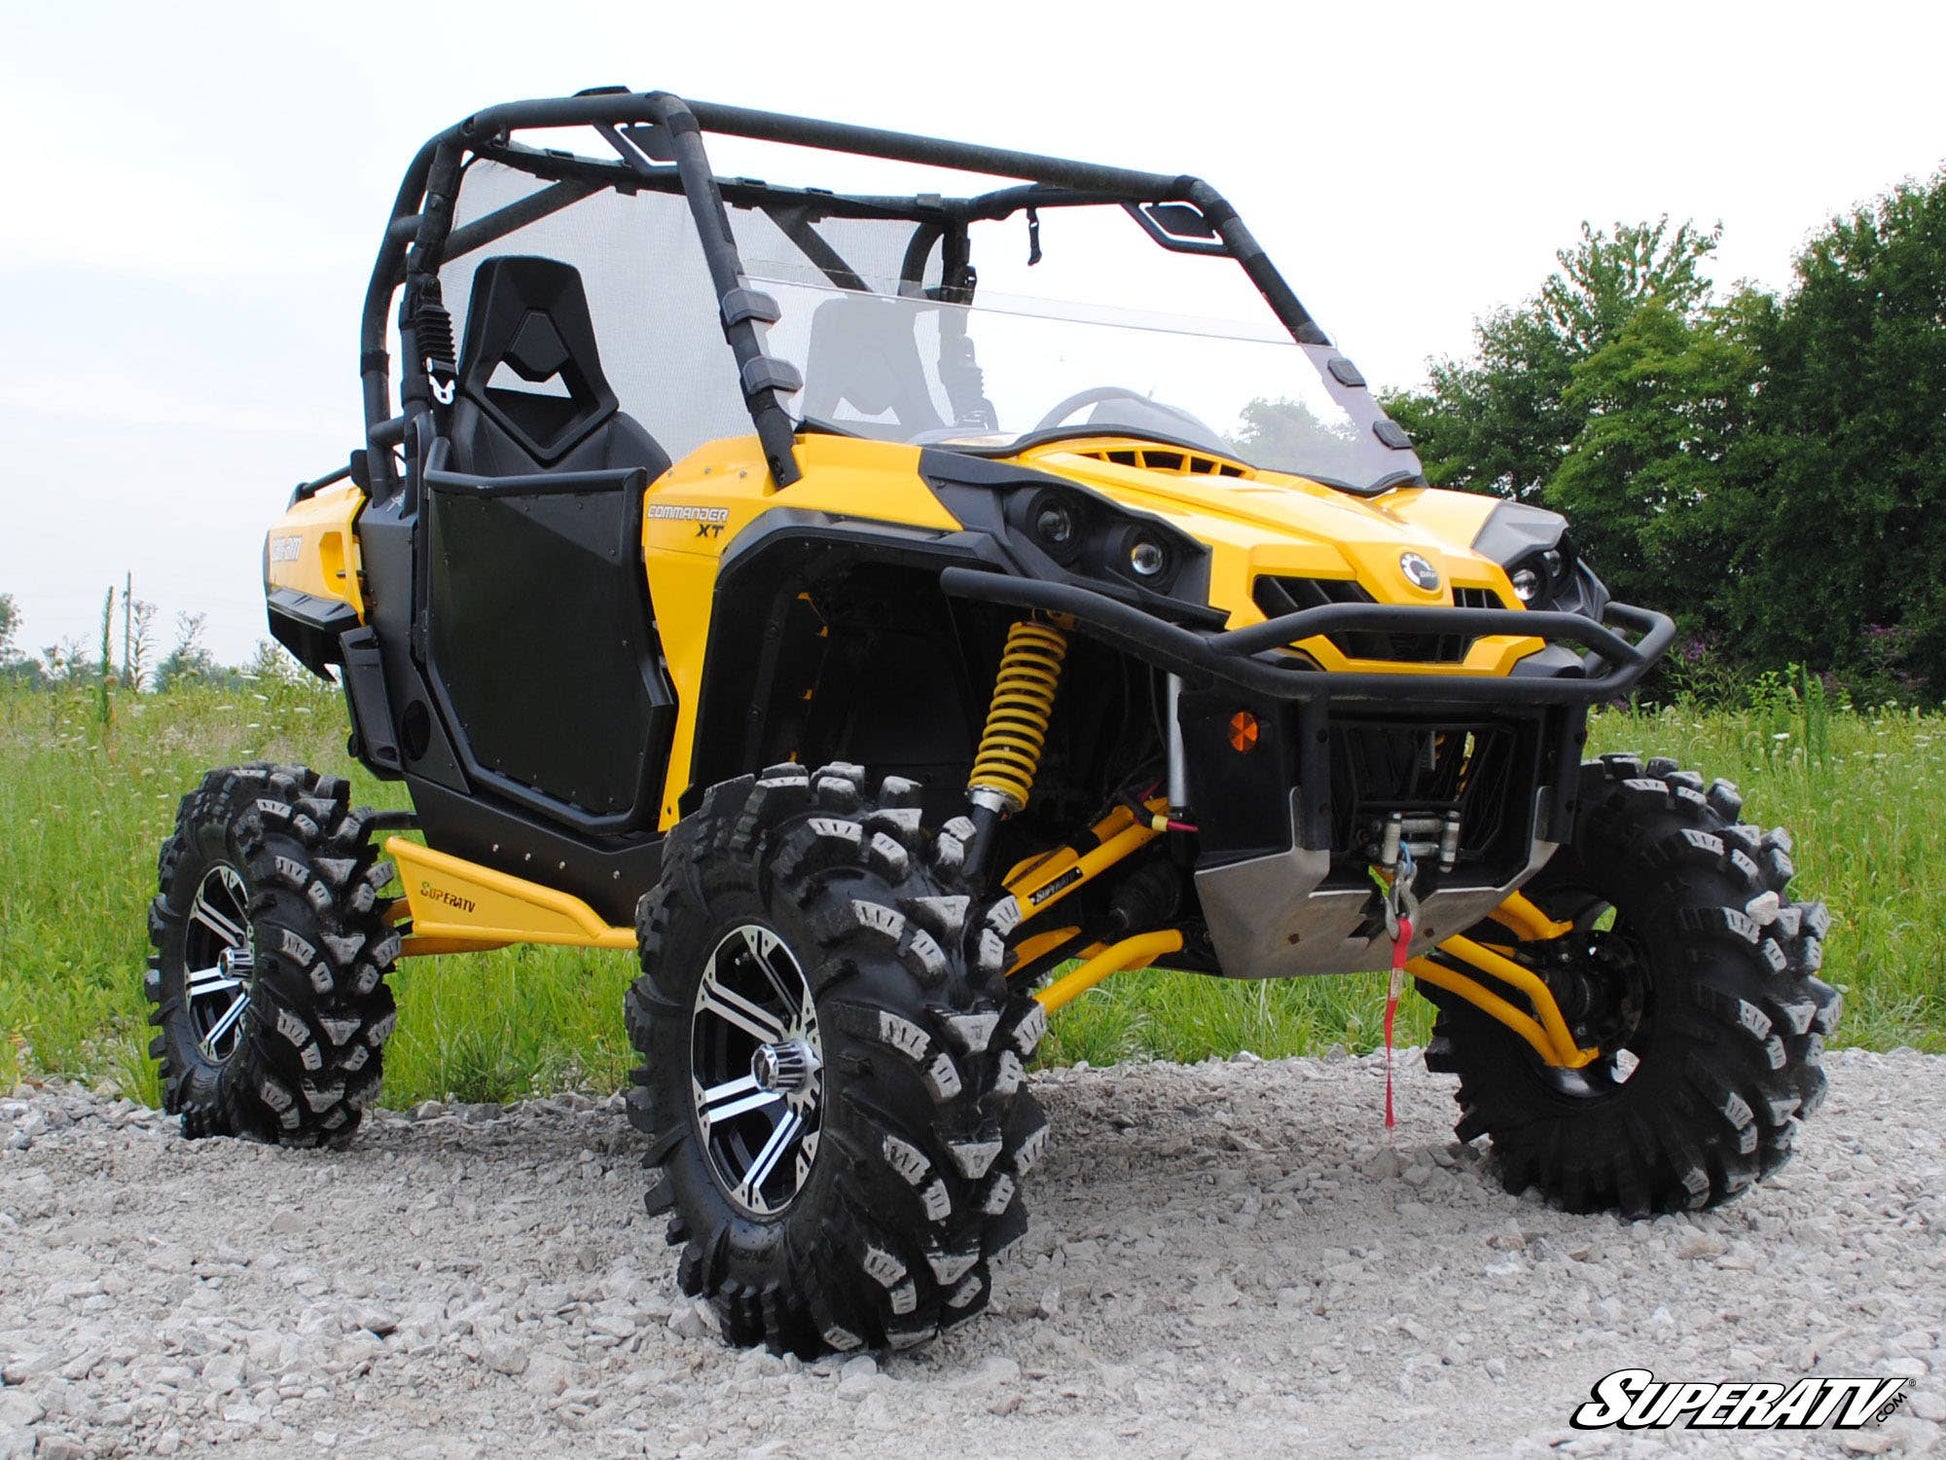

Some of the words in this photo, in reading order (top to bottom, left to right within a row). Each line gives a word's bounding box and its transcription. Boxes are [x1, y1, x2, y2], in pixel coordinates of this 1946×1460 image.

[648, 504, 729, 522] COMMANDER
[696, 524, 724, 539] XT
[420, 881, 476, 913] SUPERATV
